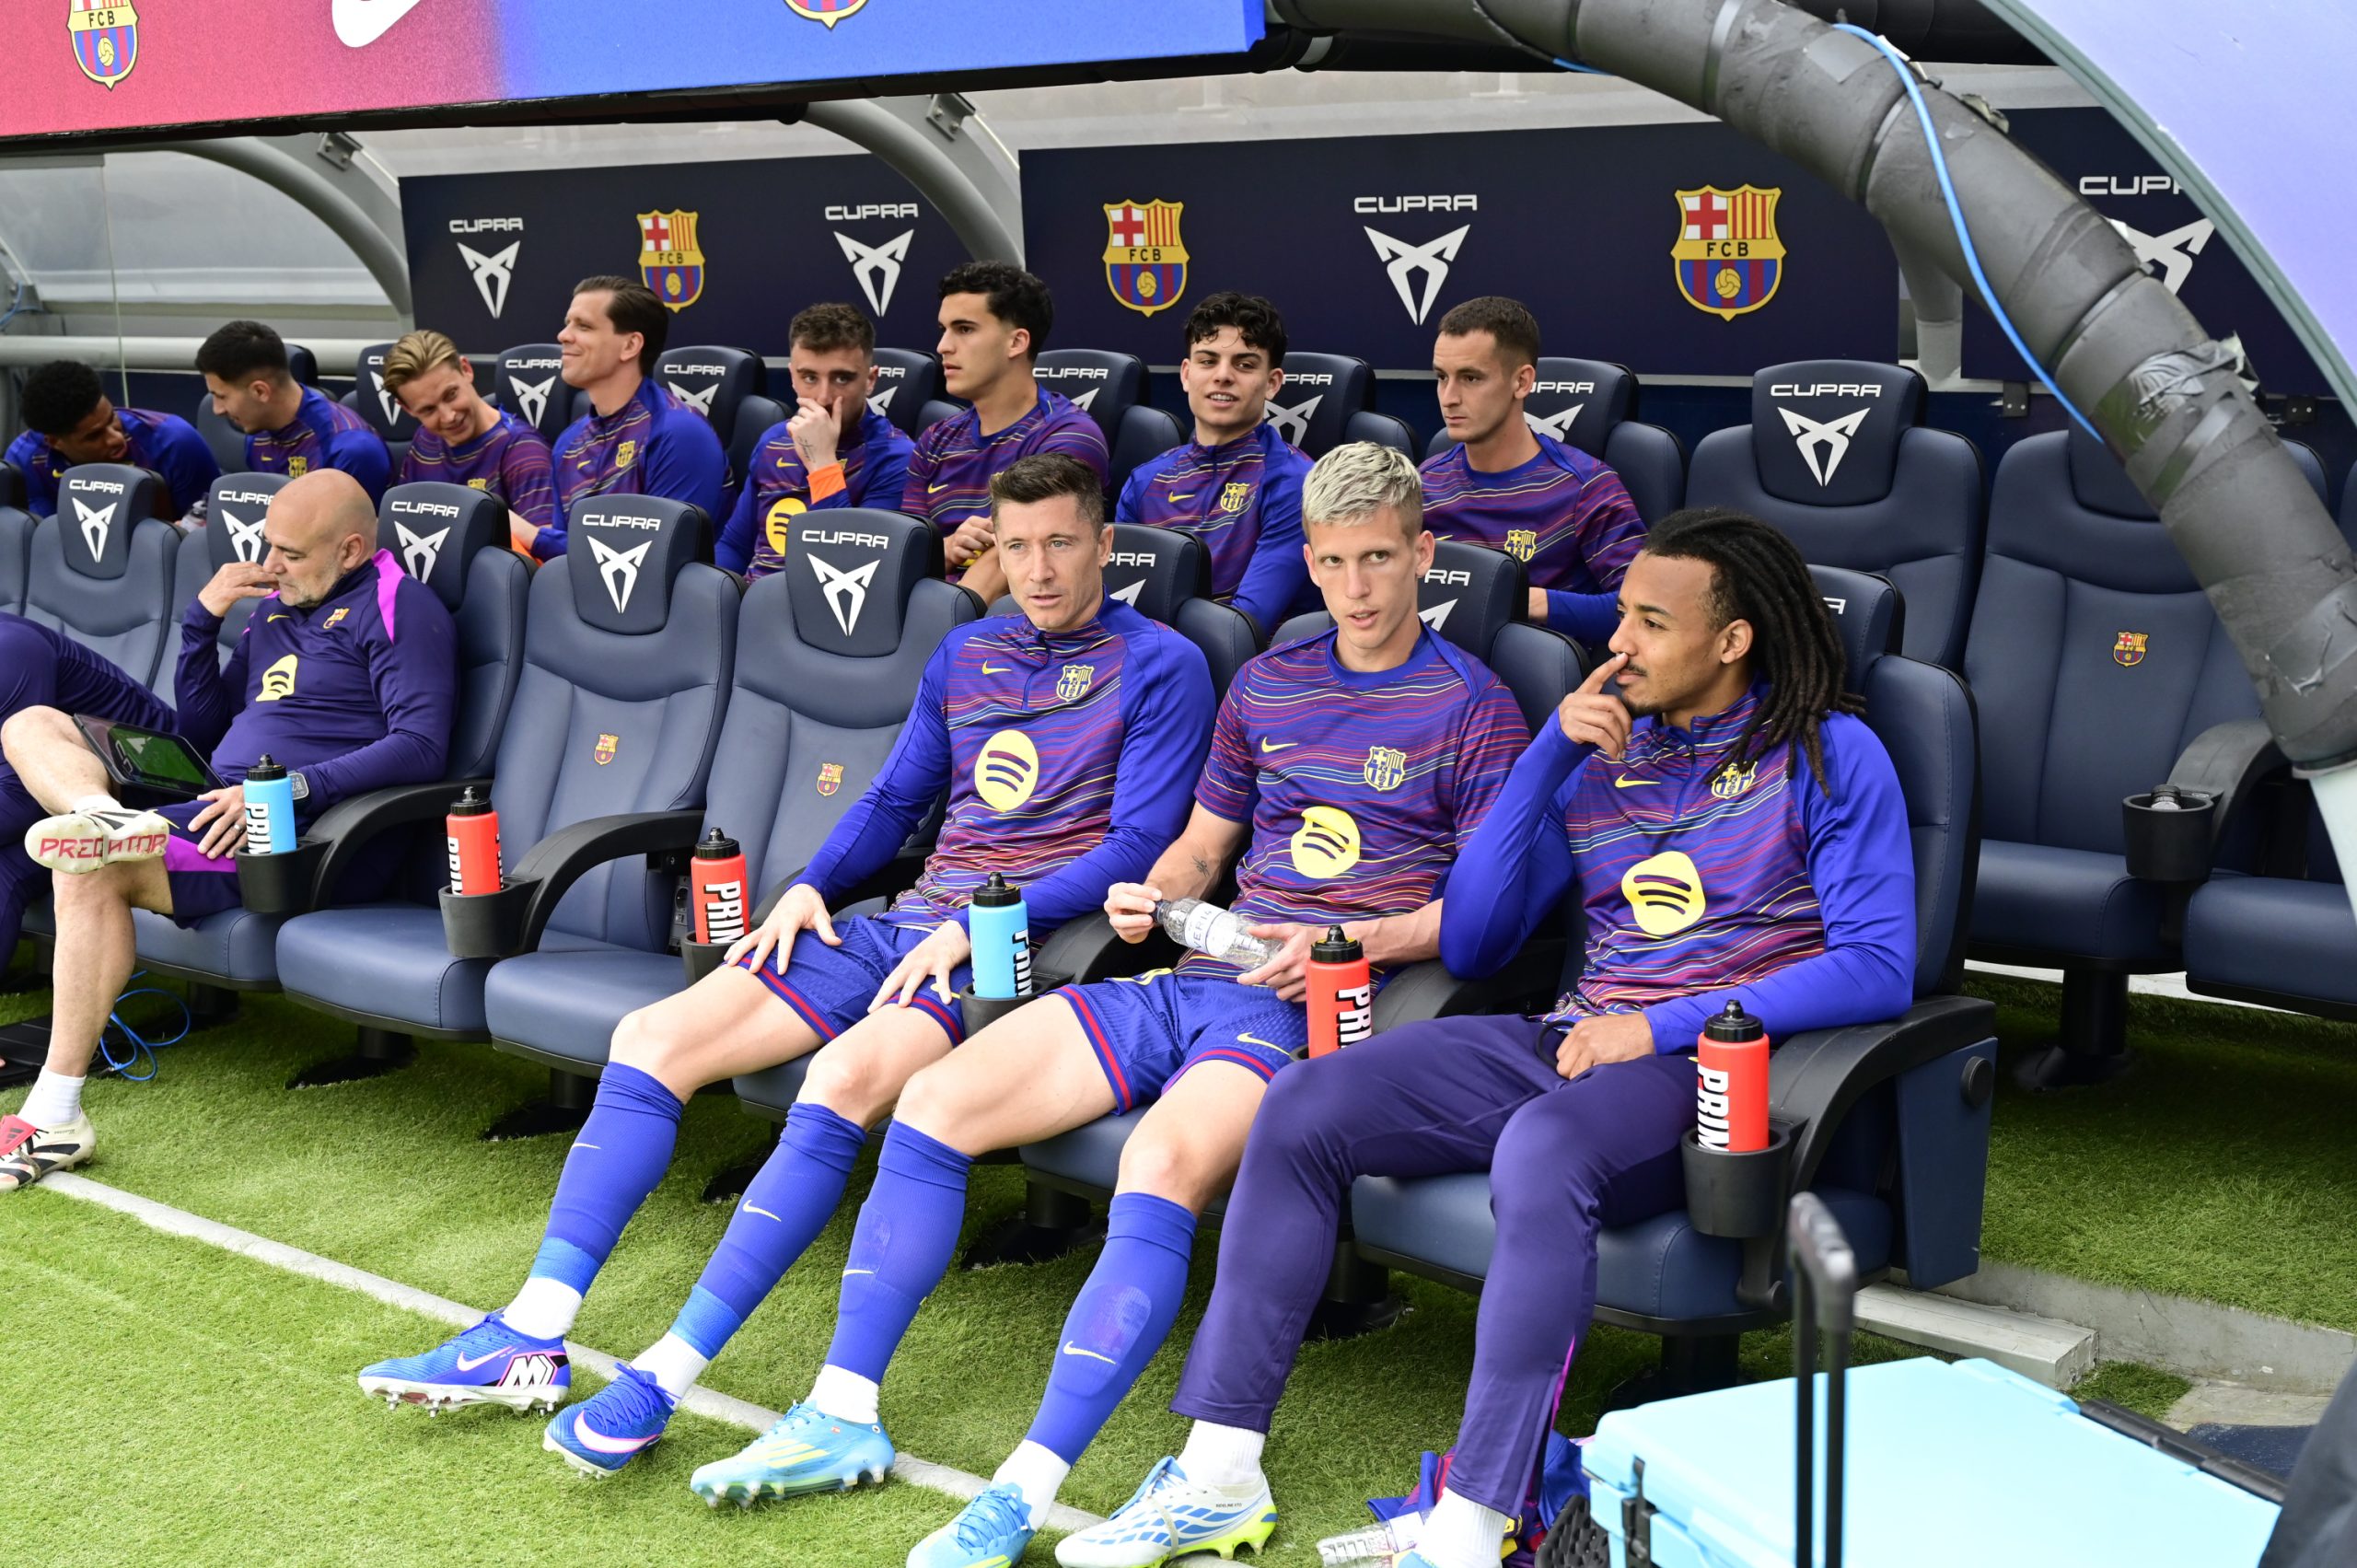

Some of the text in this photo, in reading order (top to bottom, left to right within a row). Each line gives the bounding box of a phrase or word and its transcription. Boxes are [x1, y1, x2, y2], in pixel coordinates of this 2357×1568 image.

[88, 10, 115, 28] FCB
[2080, 176, 2182, 194] CUP
[825, 203, 919, 220] CUPRA
[1354, 194, 1477, 213] CUPRA
[449, 217, 523, 233] CUPRA
[1129, 248, 1162, 261] FCB
[1707, 241, 1748, 257] FCB
[658, 252, 684, 264] FCB
[505, 359, 563, 369] CUPRA
[664, 364, 726, 376] CUPRA
[1032, 367, 1109, 379] CUPRA
[1283, 374, 1332, 385] PRA
[1530, 382, 1595, 394] PRA
[1771, 384, 1882, 397] CUPRA
[69, 479, 124, 494] CUPRA
[391, 501, 459, 517] CUPRA
[582, 514, 661, 531] CUPRA
[802, 529, 888, 550] CUPRA
[1336, 983, 1372, 1048] PRI
